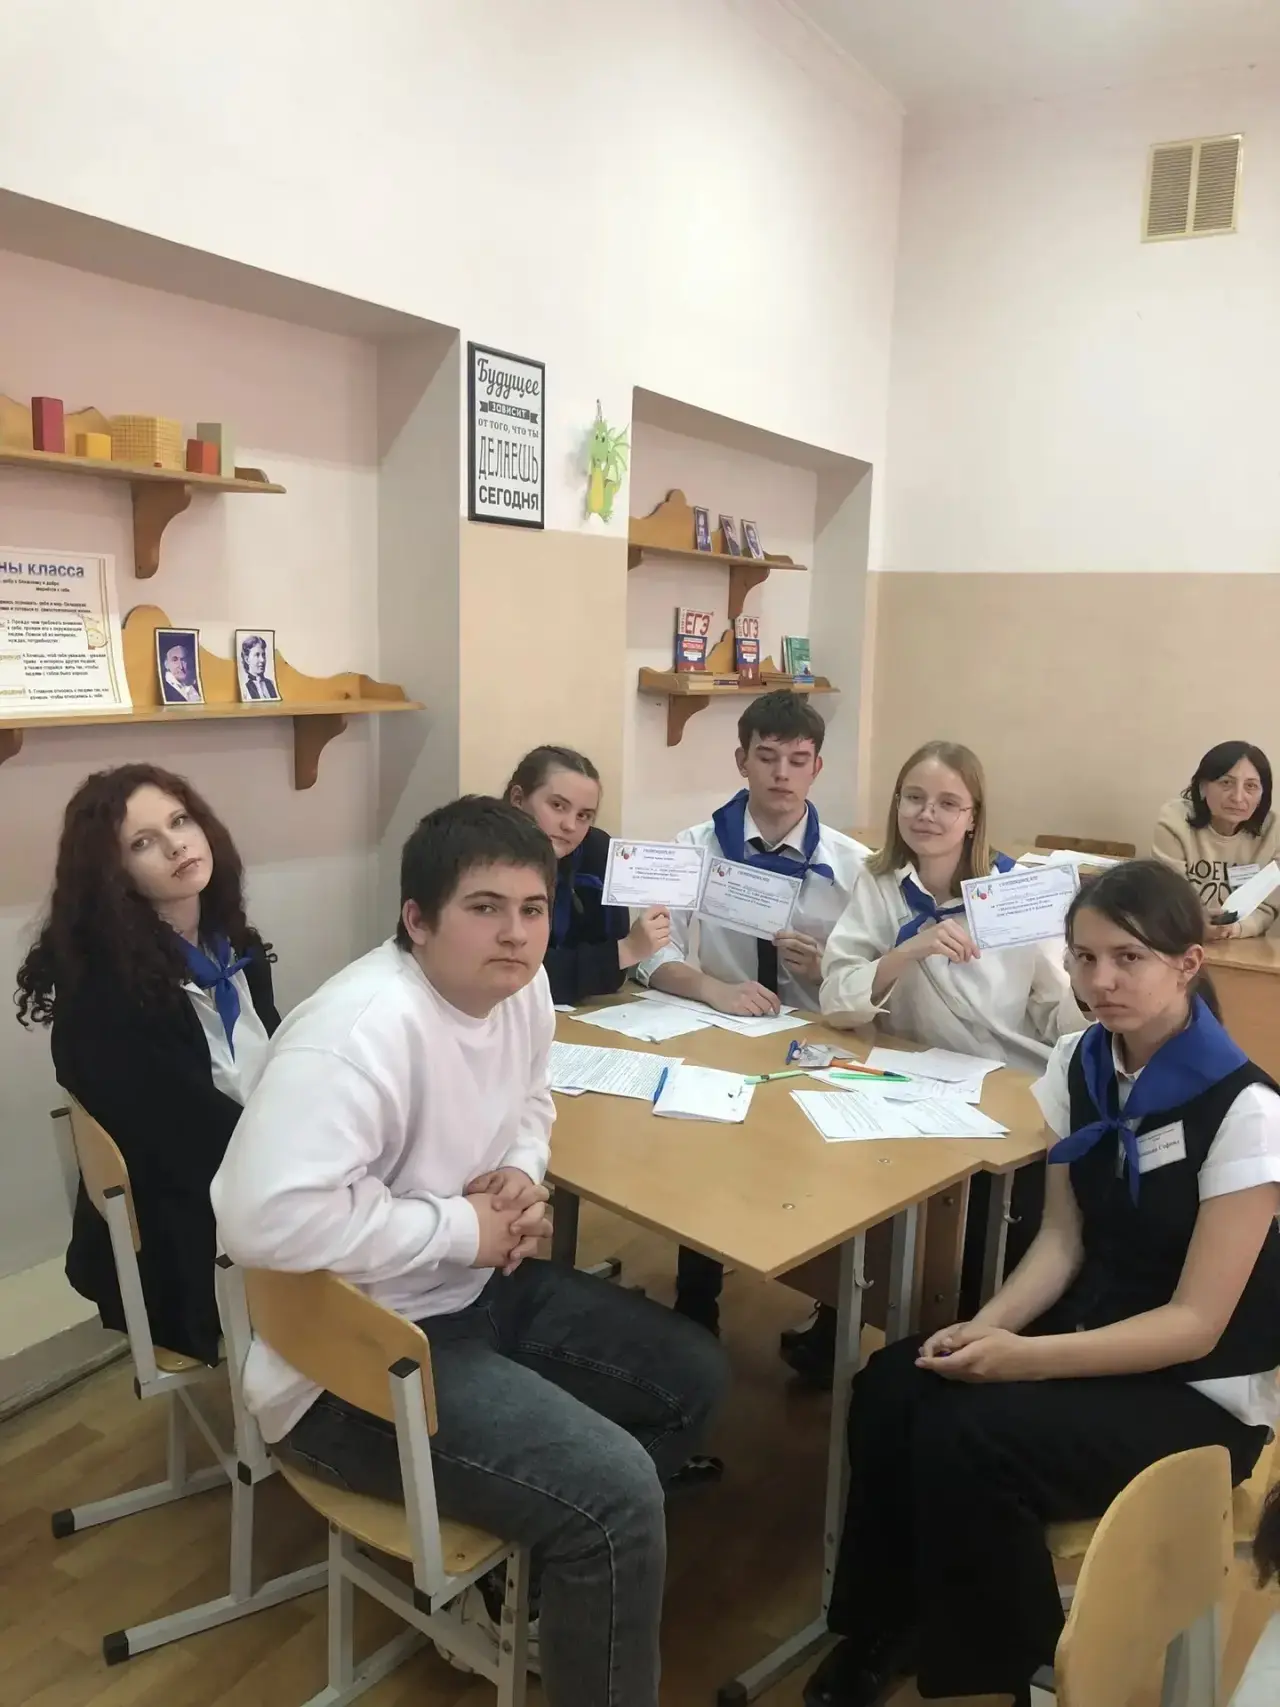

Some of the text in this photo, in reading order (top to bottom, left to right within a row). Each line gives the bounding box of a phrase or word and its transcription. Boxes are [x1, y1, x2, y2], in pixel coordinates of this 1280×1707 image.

[477, 358, 540, 399] Будущее
[478, 418, 489, 427] ОТ
[512, 425, 527, 435] ЧТО
[528, 429, 539, 438] ТЫ
[478, 435, 539, 484] ДЕЛАЕШЬ
[478, 485, 539, 510] СЕГОДНЯ
[27, 563, 85, 578] класса
[685, 612, 710, 635] ЕГЭ
[742, 618, 759, 637] ОГЭ
